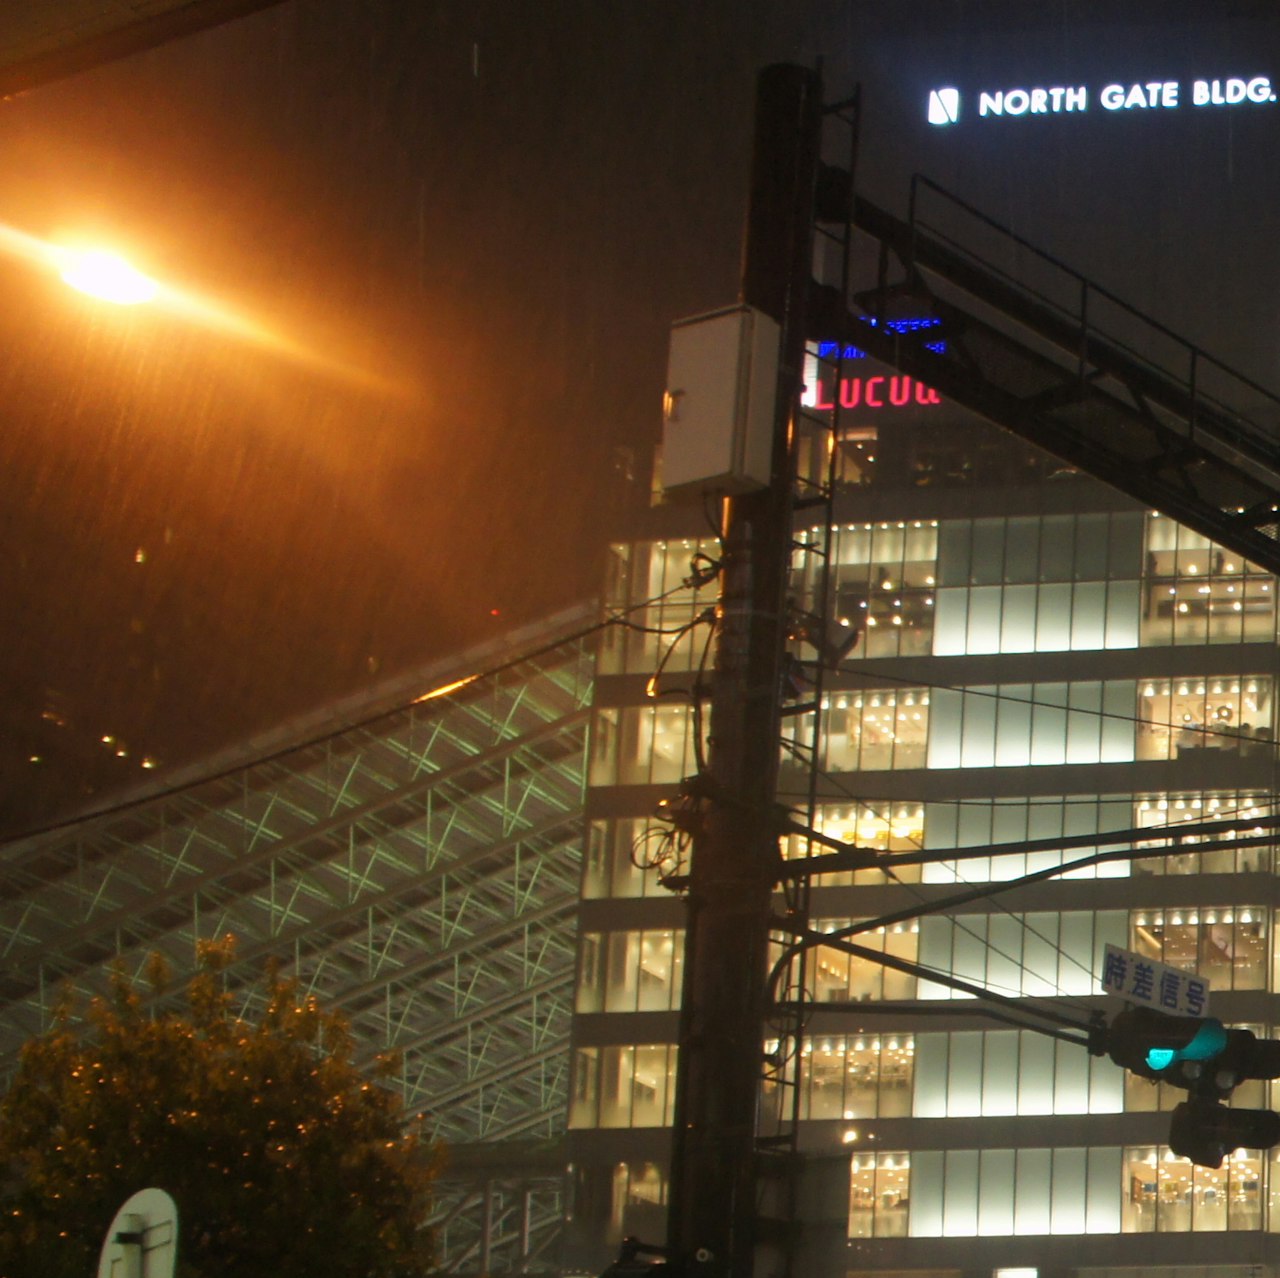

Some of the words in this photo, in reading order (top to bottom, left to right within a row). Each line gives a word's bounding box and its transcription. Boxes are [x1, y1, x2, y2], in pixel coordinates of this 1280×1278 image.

[979, 87, 1087, 116] NORTH
[1100, 82, 1179, 110] GATE
[1193, 77, 1277, 106] BLDG.
[1105, 952, 1206, 1018] 時差信号
